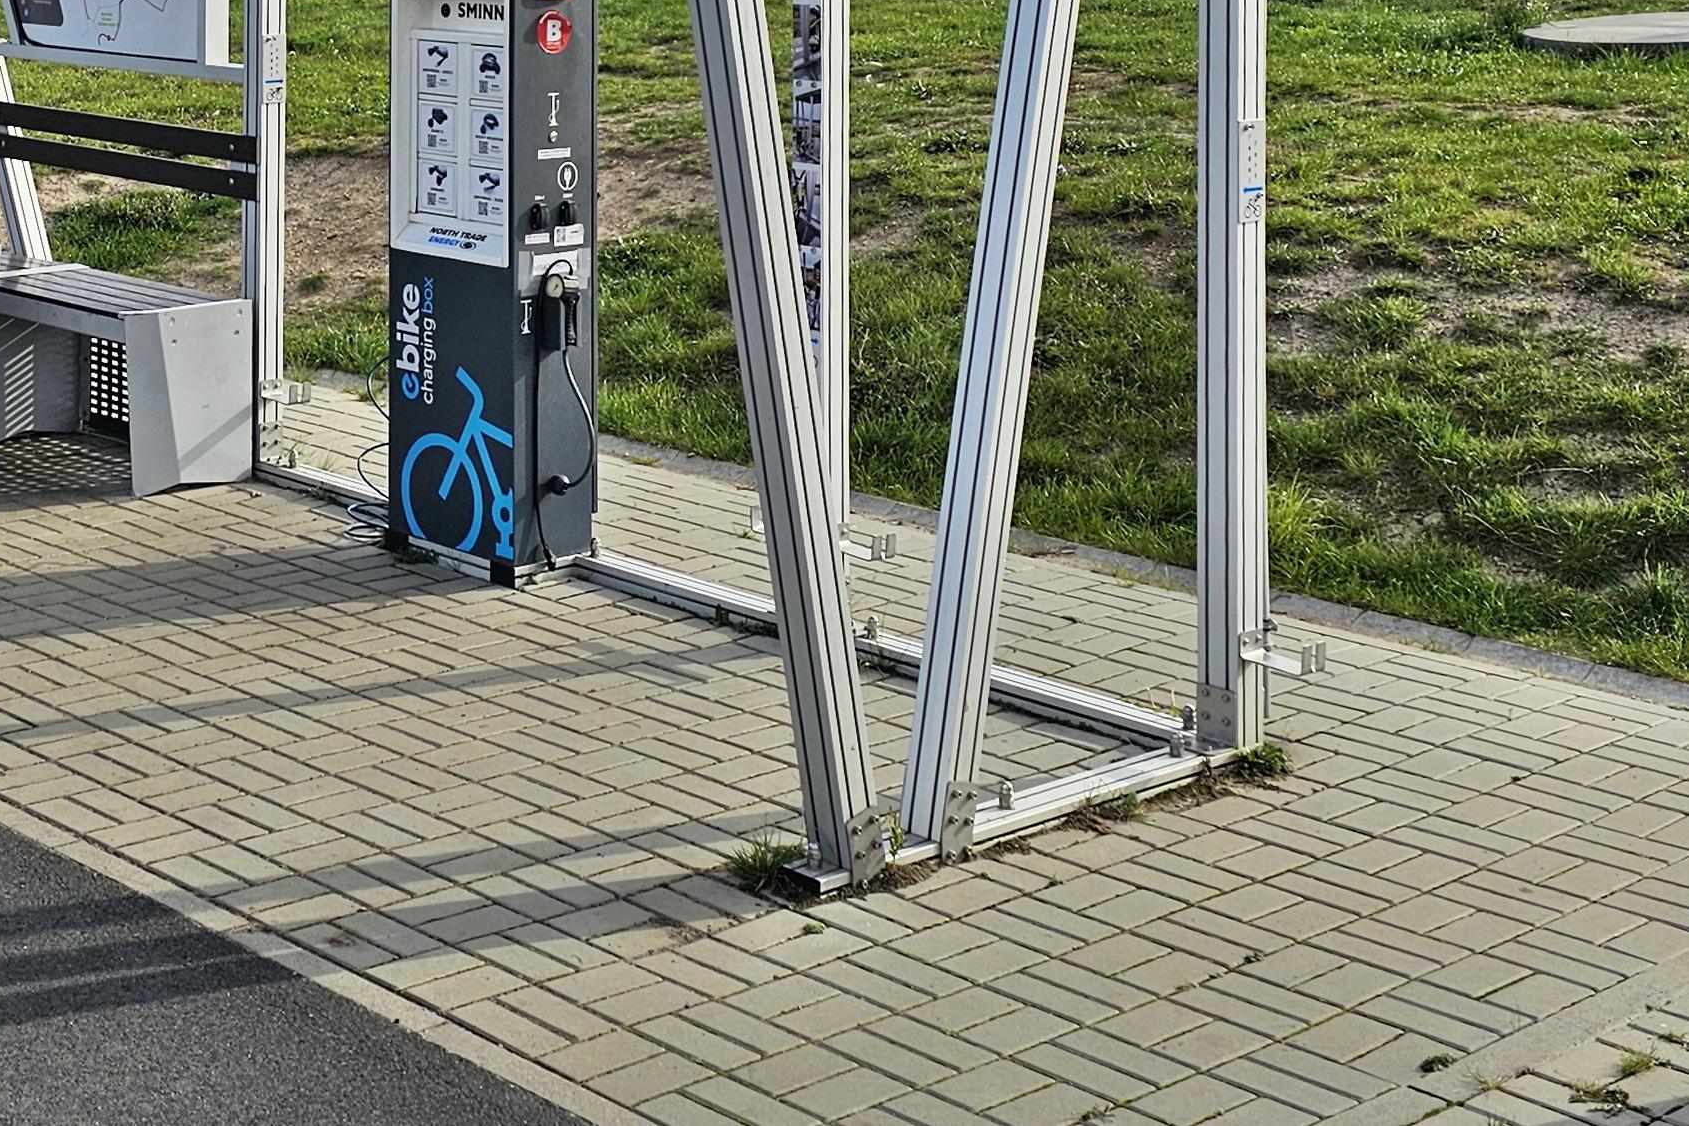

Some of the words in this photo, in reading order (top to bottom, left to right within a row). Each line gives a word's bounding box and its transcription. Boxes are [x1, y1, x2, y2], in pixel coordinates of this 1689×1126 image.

[457, 1, 505, 21] SMINN
[546, 19, 562, 42] B
[427, 235, 460, 247] ENERGY
[429, 226, 460, 238] NORTH
[460, 231, 488, 242] TRADE
[421, 276, 434, 314] box
[396, 283, 421, 400] ebike
[420, 316, 437, 405] charging
